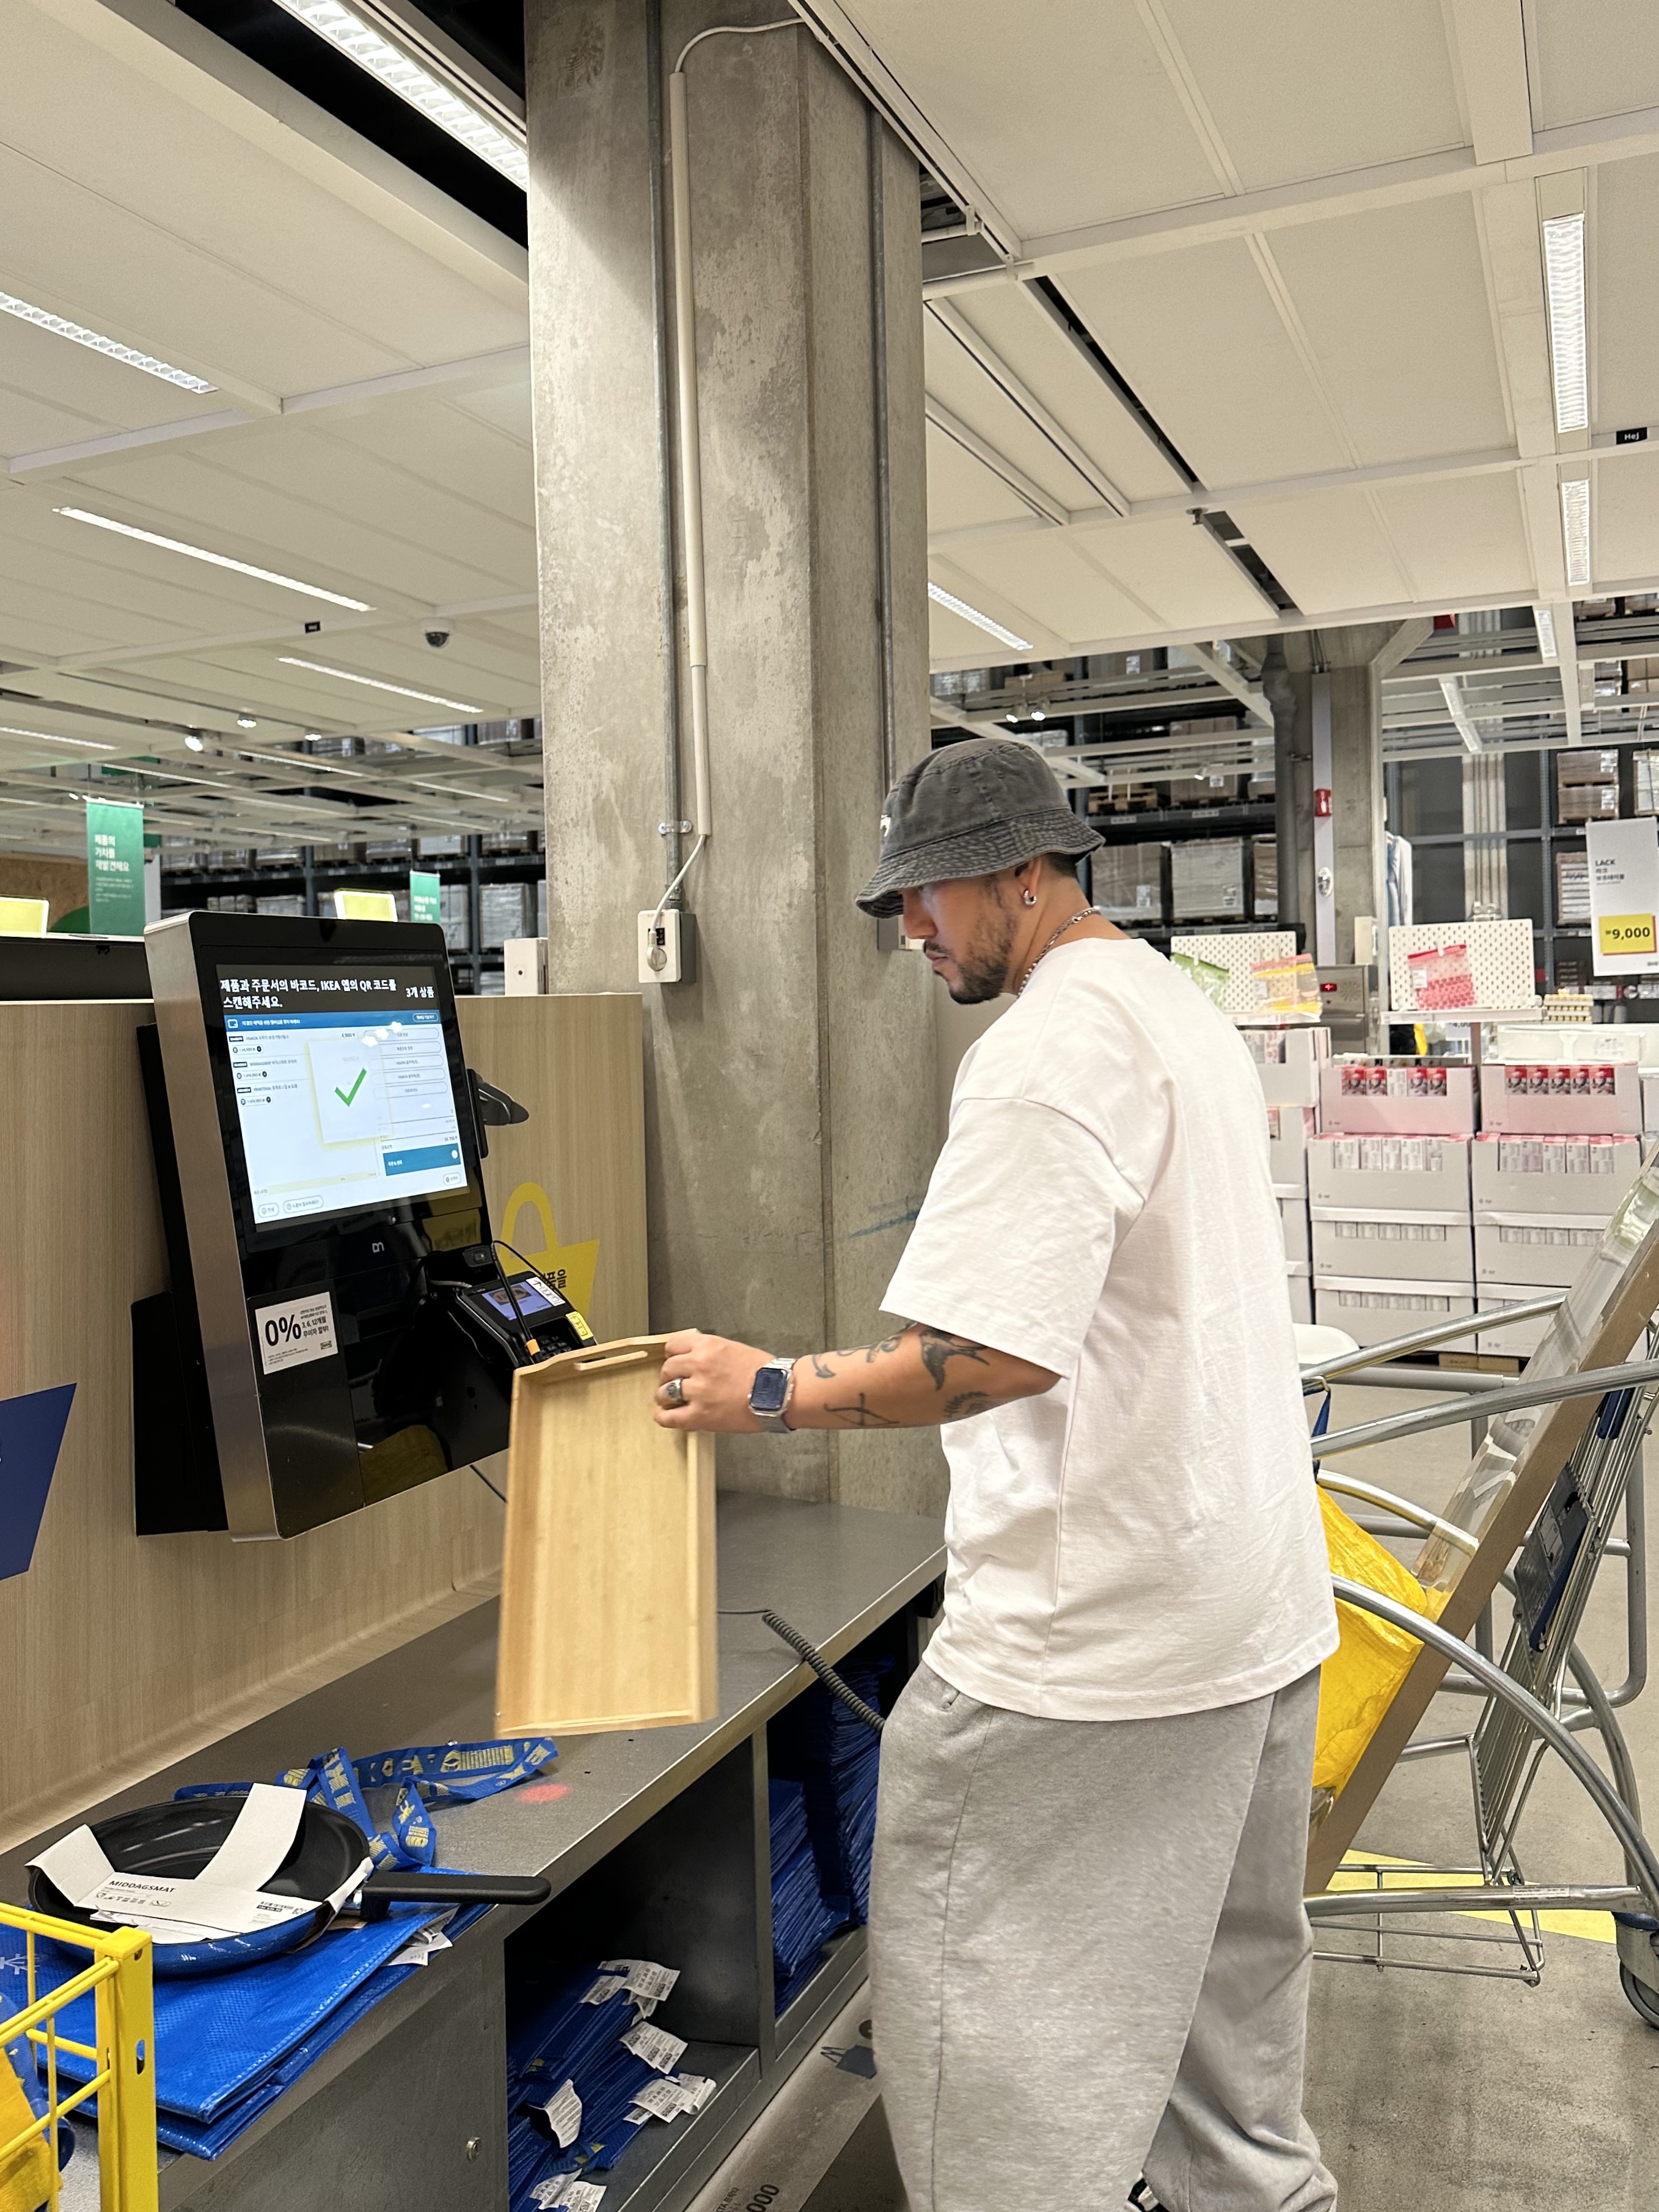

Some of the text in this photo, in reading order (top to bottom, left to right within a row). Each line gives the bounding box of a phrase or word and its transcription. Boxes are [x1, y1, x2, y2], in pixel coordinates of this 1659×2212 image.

[1624, 432, 1639, 441] Hej
[1595, 859, 1616, 867] LACK
[220, 979, 397, 993] 제품과 주문서의 바코드, IKEA 앱의 QR 코드를
[406, 986, 434, 998] 3개 상품
[223, 996, 283, 1010] 스캔해주세요.
[265, 1314, 301, 1347] 0%
[303, 1328, 318, 1338] 무이자
[108, 1880, 177, 1893] MIDDAGSMAT
